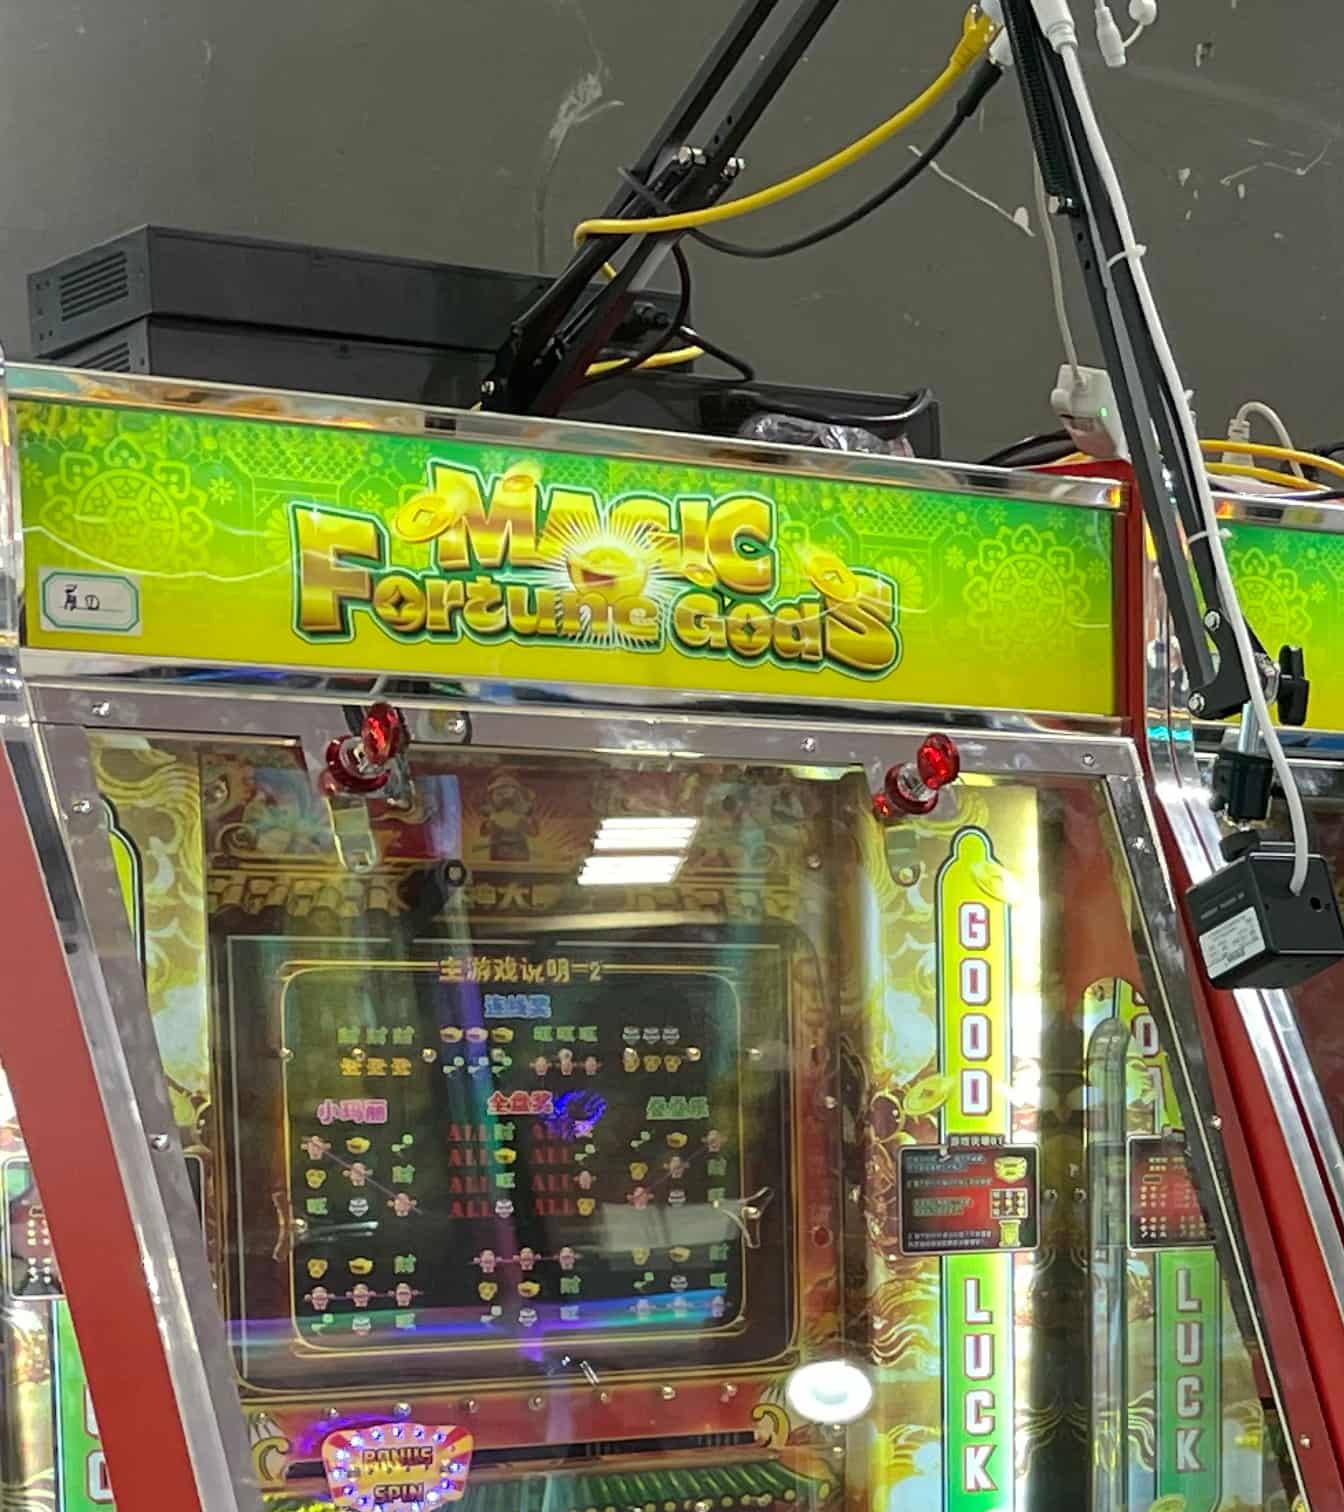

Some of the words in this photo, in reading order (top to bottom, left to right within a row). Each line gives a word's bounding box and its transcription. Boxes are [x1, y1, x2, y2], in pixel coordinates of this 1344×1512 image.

[429, 459, 776, 595] MAGIC
[958, 900, 991, 1117] GOOD
[962, 1277, 995, 1495] LUCK
[1174, 1268, 1206, 1474] LUCK
